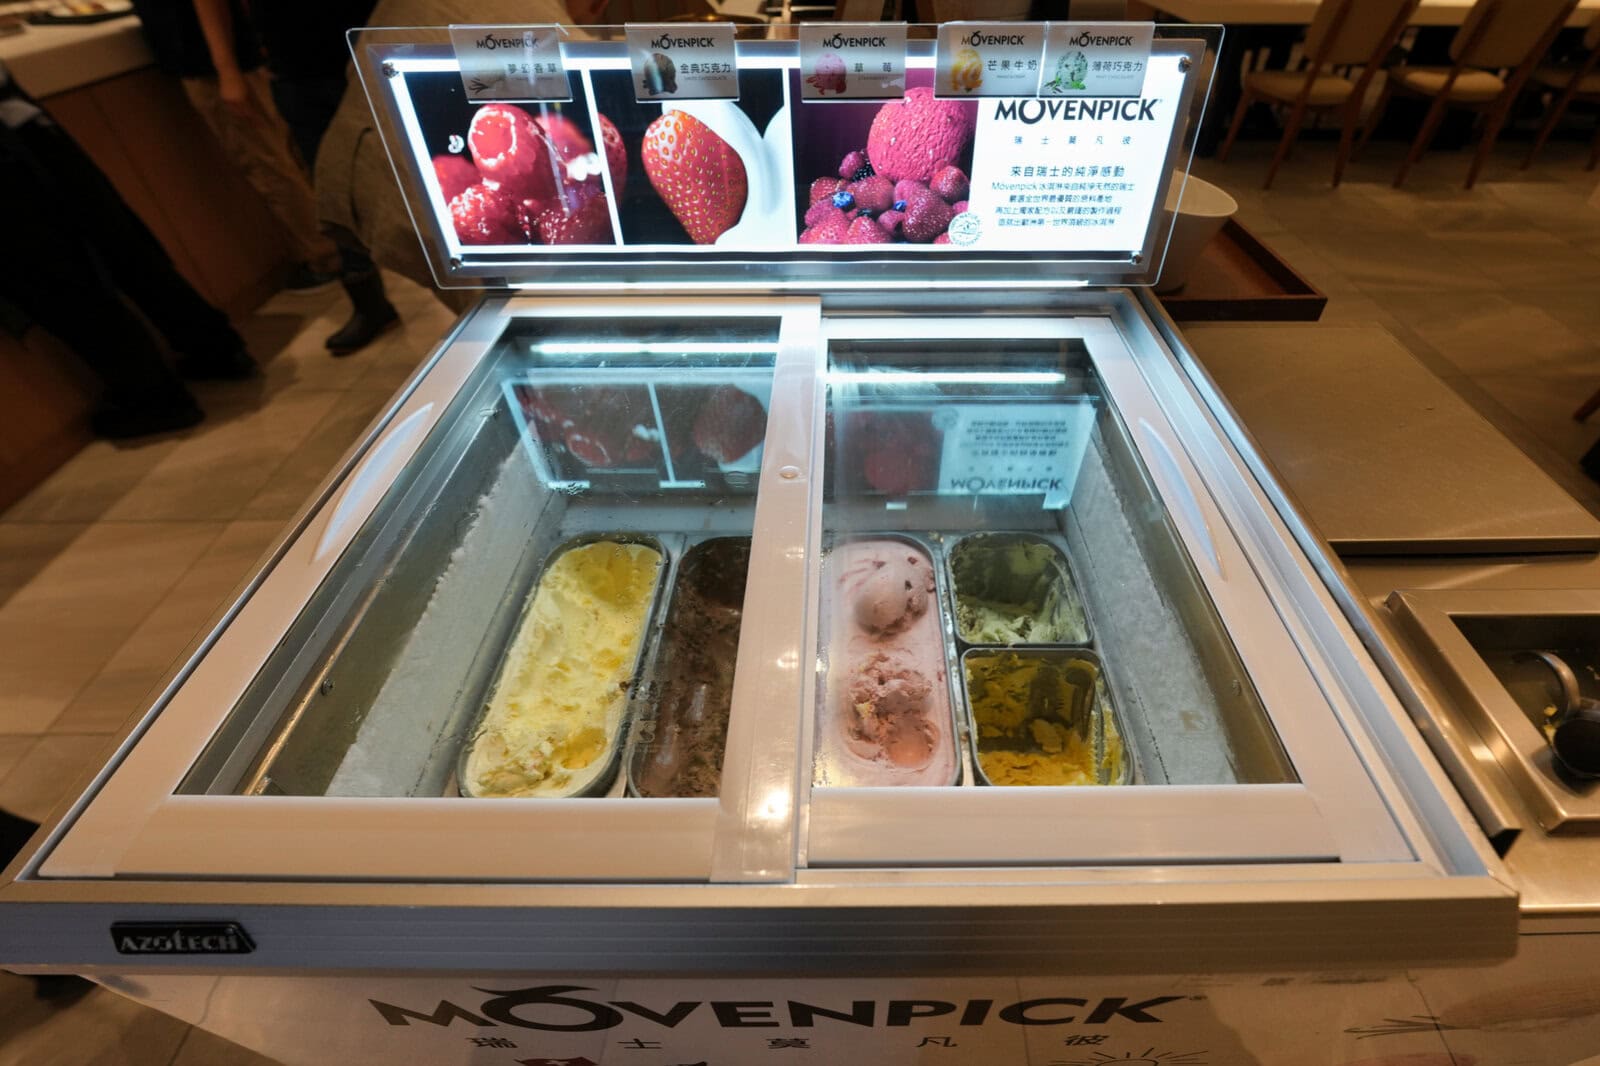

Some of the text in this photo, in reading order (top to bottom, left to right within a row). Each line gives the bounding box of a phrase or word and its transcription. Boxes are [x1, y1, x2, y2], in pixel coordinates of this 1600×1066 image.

[680, 63, 731, 74] 金典巧克力
[854, 62, 892, 72] 草莓
[987, 59, 1038, 71] 芒果牛奶
[1092, 61, 1143, 72] 薄荷巧克力
[1010, 165, 1126, 178] 來自瑞士的純淨感動
[467, 1034, 1109, 1049] 瑞士莫凡彼
